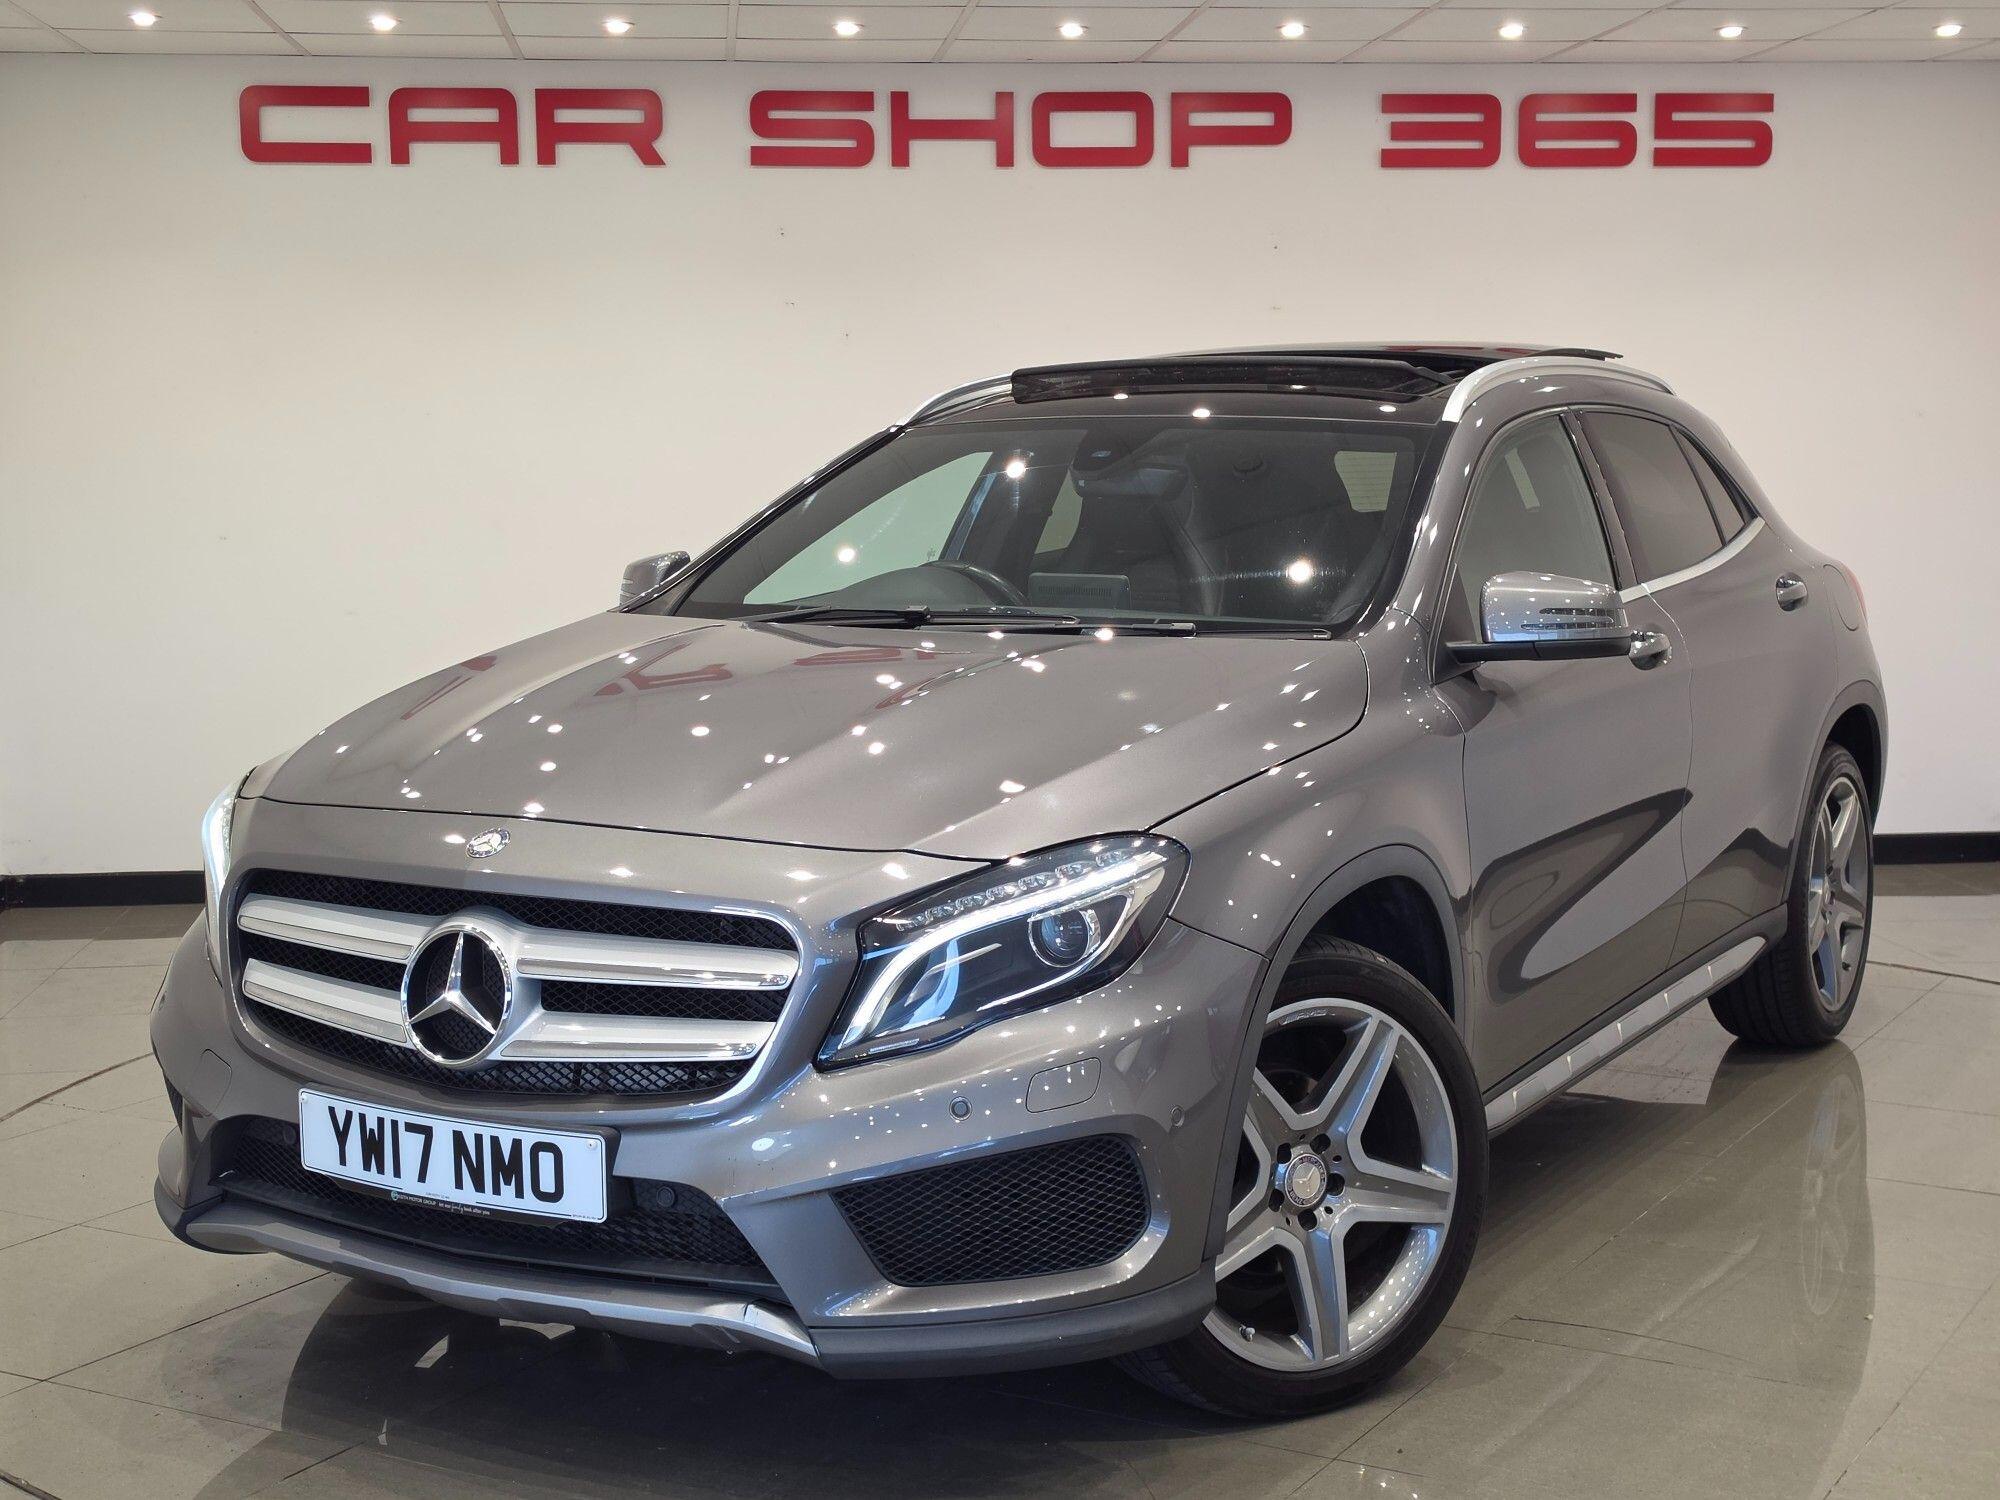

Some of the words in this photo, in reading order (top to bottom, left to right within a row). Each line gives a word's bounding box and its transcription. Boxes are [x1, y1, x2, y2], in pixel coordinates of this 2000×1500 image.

[240, 86, 664, 165] CAR
[750, 90, 1292, 167] SHOP
[1381, 93, 1773, 168] 365
[328, 1105, 433, 1184] YW17
[452, 1129, 564, 1204] NMO
